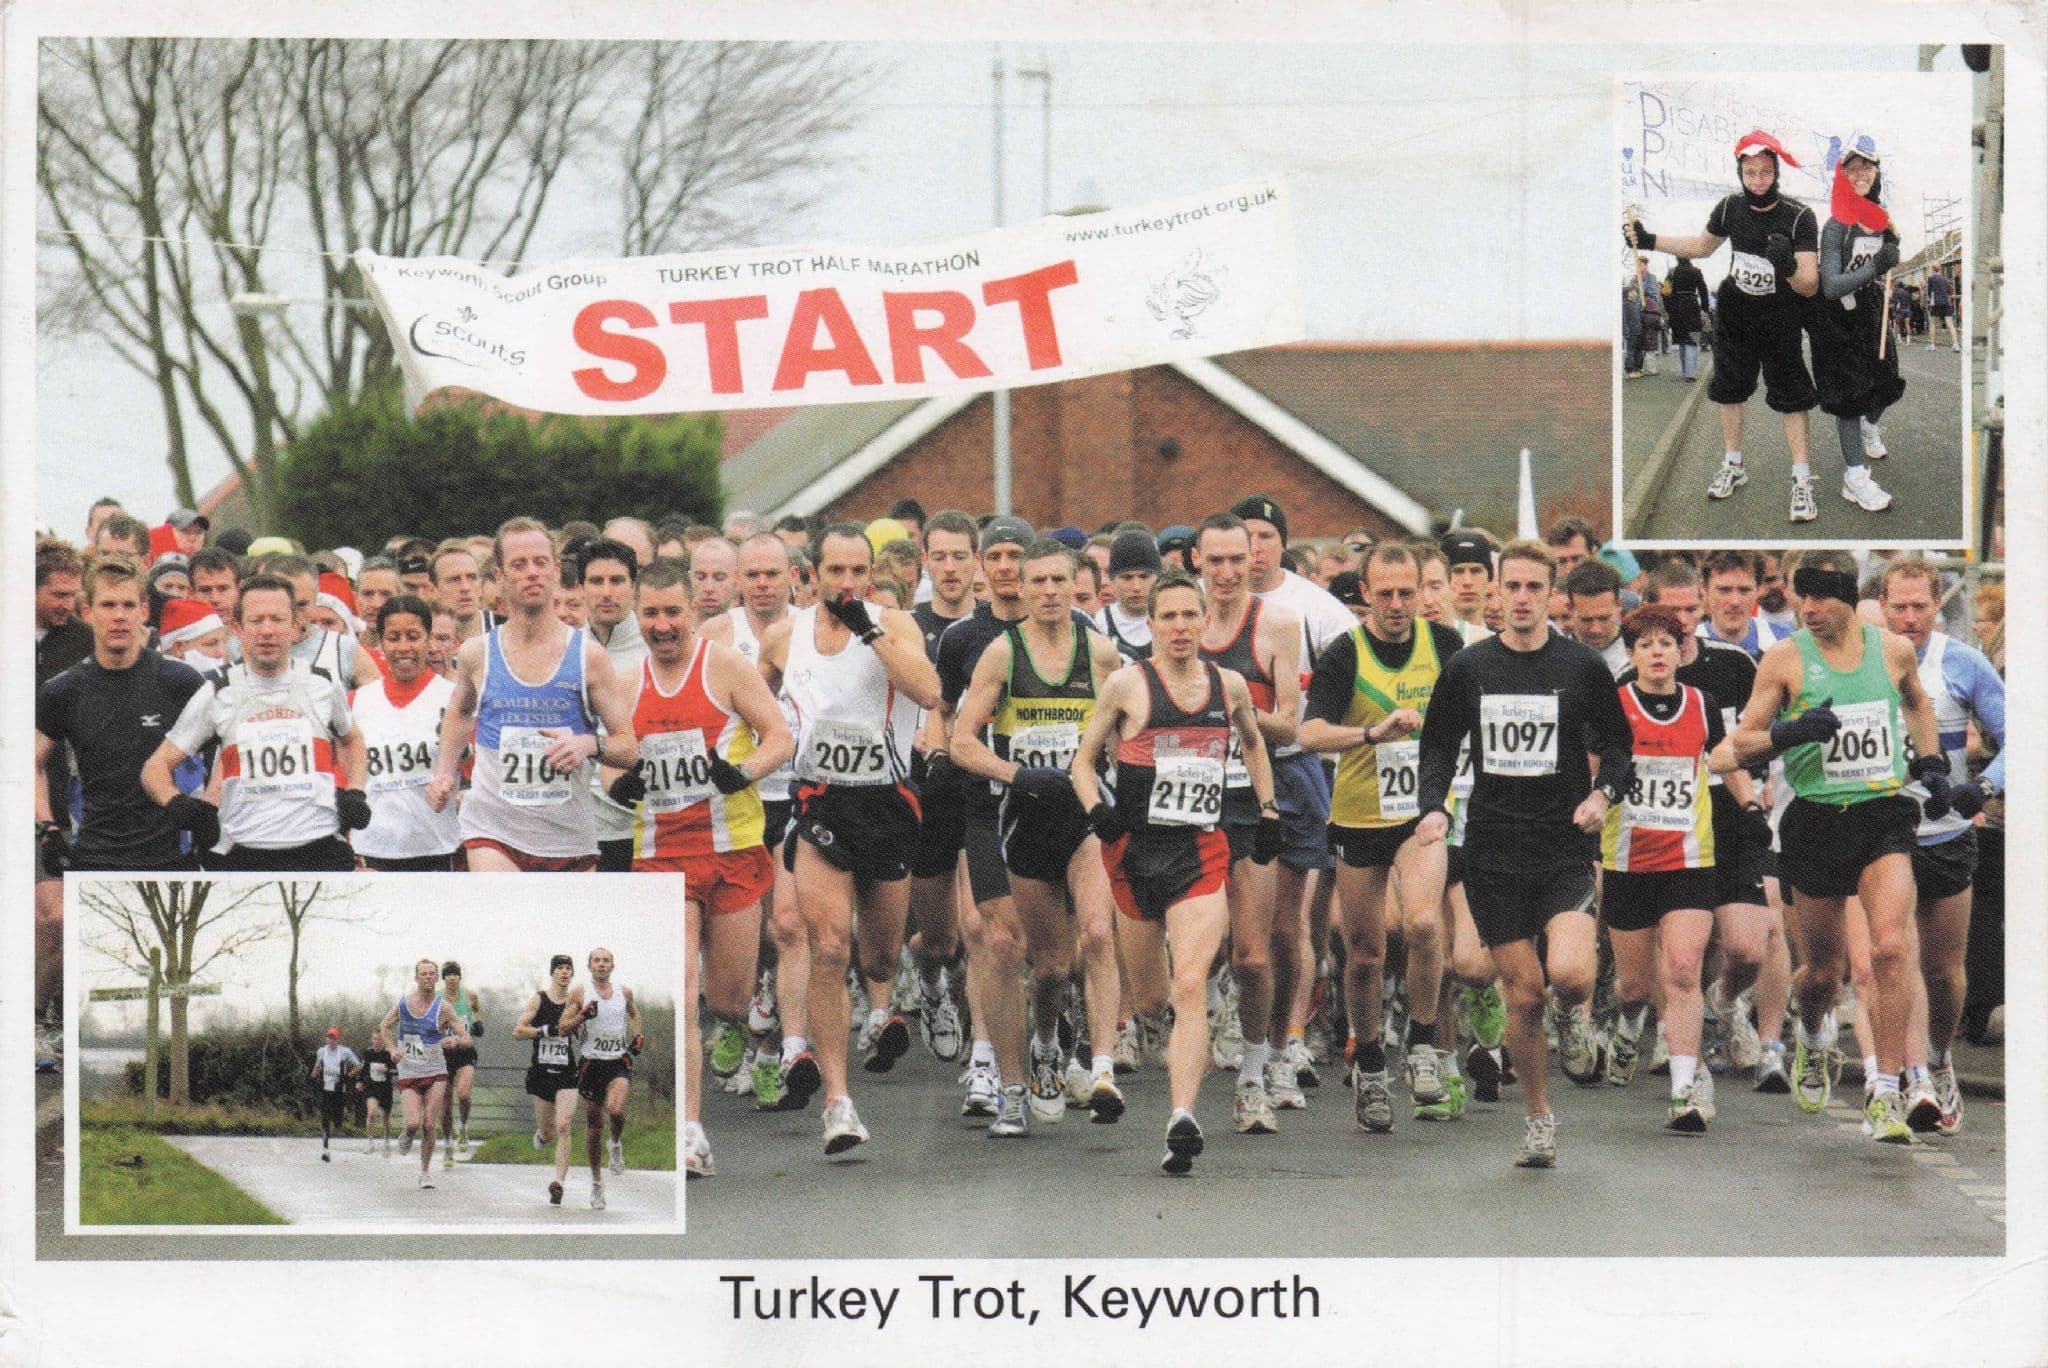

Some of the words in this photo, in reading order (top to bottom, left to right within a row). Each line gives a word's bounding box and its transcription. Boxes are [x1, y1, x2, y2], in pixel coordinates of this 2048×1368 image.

[1065, 187, 1278, 243] www.turkeytrot.org.uk
[656, 264, 741, 285] TURKEY
[747, 258, 805, 278] TROT
[810, 254, 862, 272] HALF
[867, 249, 981, 278] MARATHON
[493, 282, 543, 304] Scout
[546, 271, 608, 291] Group
[571, 260, 1079, 402] START
[1016, 706, 1087, 722] NORTHBROOK
[1488, 721, 1556, 752] 1097
[1827, 726, 1890, 763] 2061
[246, 744, 309, 779] 1061
[367, 741, 432, 776] 8134
[645, 754, 711, 791] 2140
[816, 741, 885, 773] 2075
[1498, 759, 1521, 769] DERBY
[1523, 759, 1554, 769] RUNNER
[1153, 780, 1221, 815] 2128
[1628, 778, 1693, 810] 8135
[594, 1037, 621, 1052] 2075
